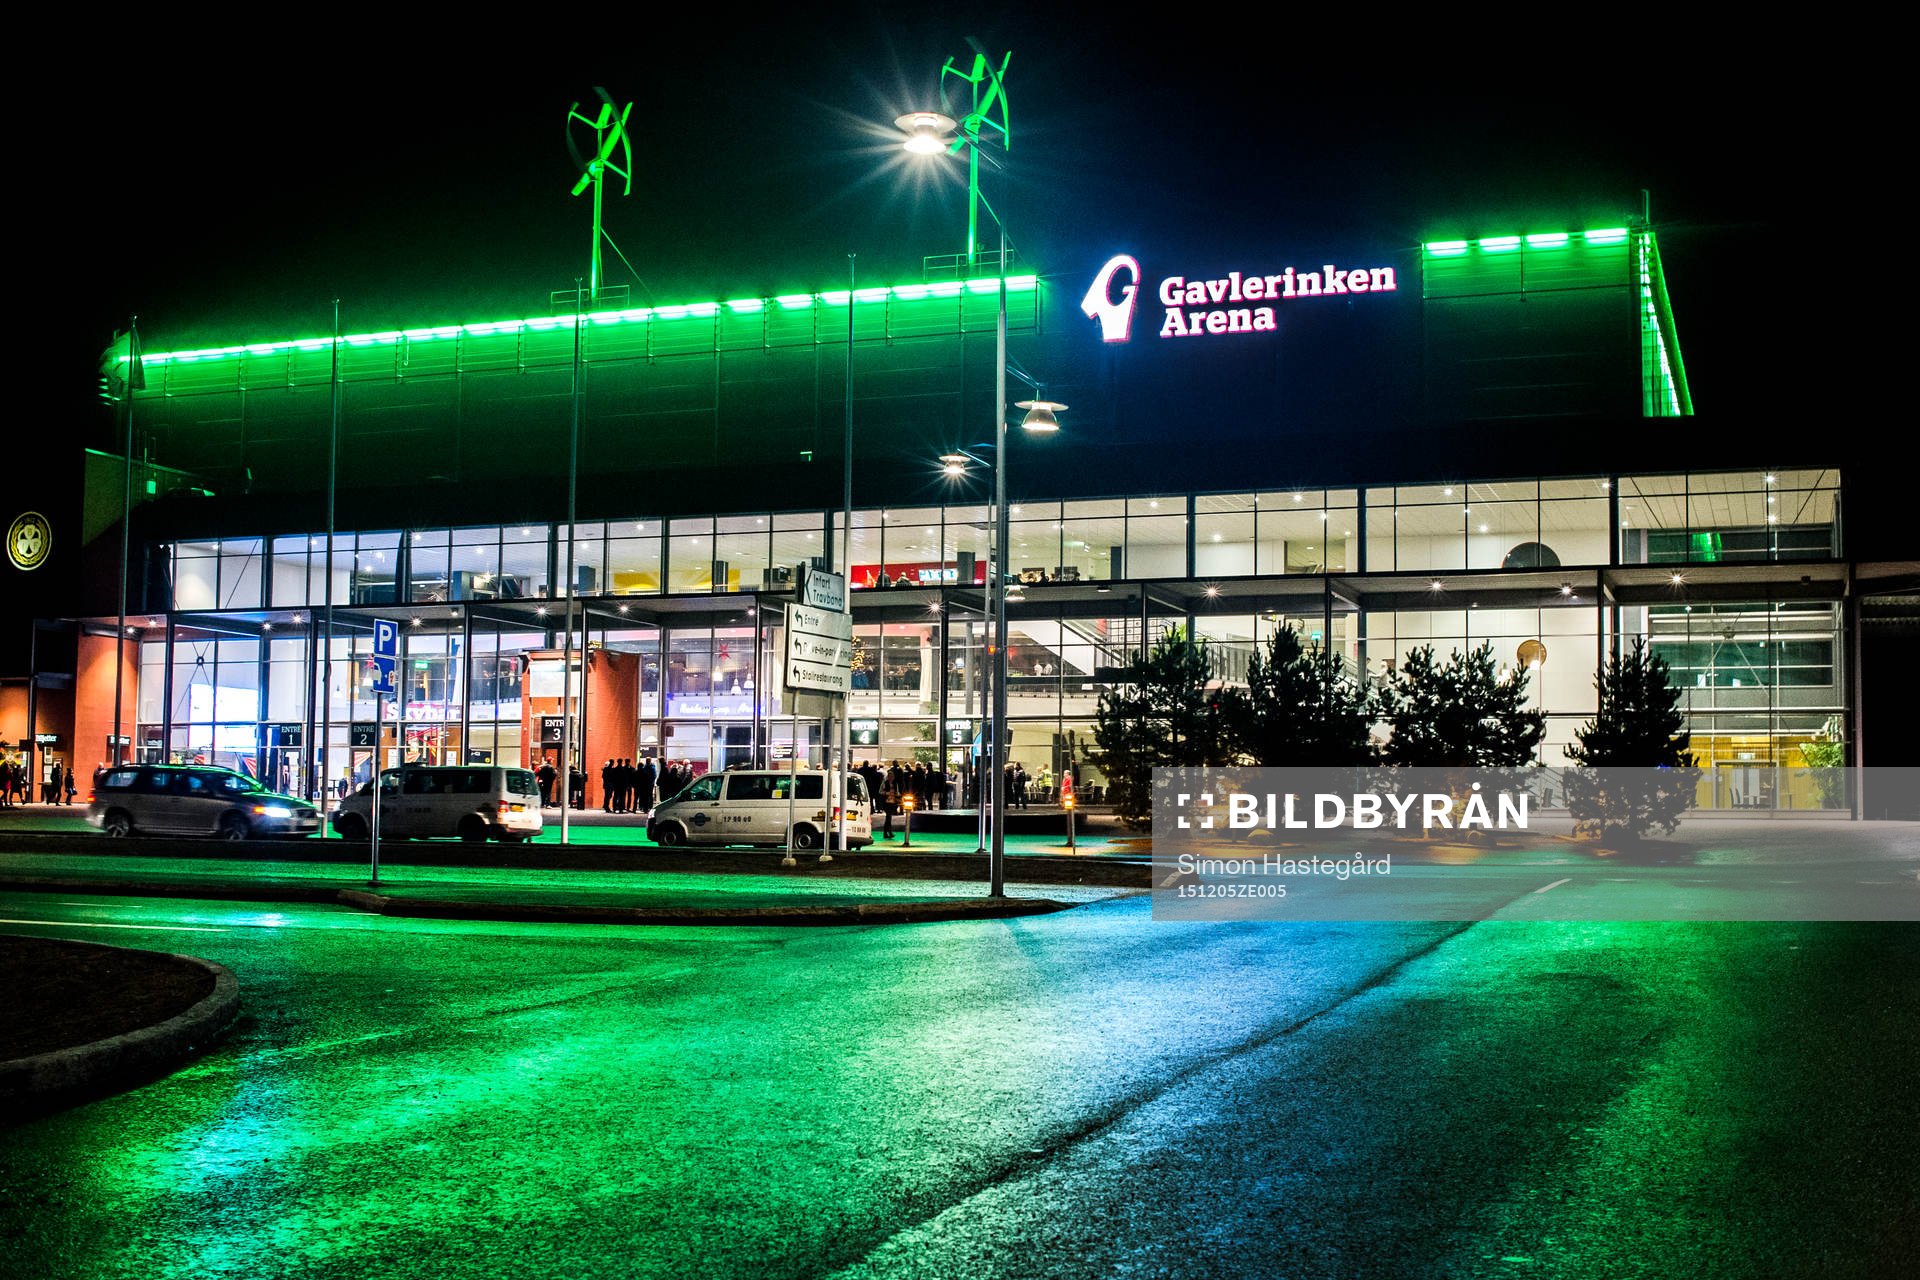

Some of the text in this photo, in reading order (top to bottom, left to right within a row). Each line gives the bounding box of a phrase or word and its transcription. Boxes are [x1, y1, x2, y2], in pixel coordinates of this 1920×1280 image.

[1159, 264, 1397, 307] Gavlerinken
[1159, 307, 1276, 338] Arena
[379, 624, 392, 651] P
[281, 724, 302, 733] ENTRÉ
[353, 724, 375, 733] ENTRÉ
[552, 728, 561, 740] 3
[288, 734, 294, 745] 1
[360, 734, 368, 745] 2
[859, 731, 869, 744] 4
[952, 730, 962, 744] 5
